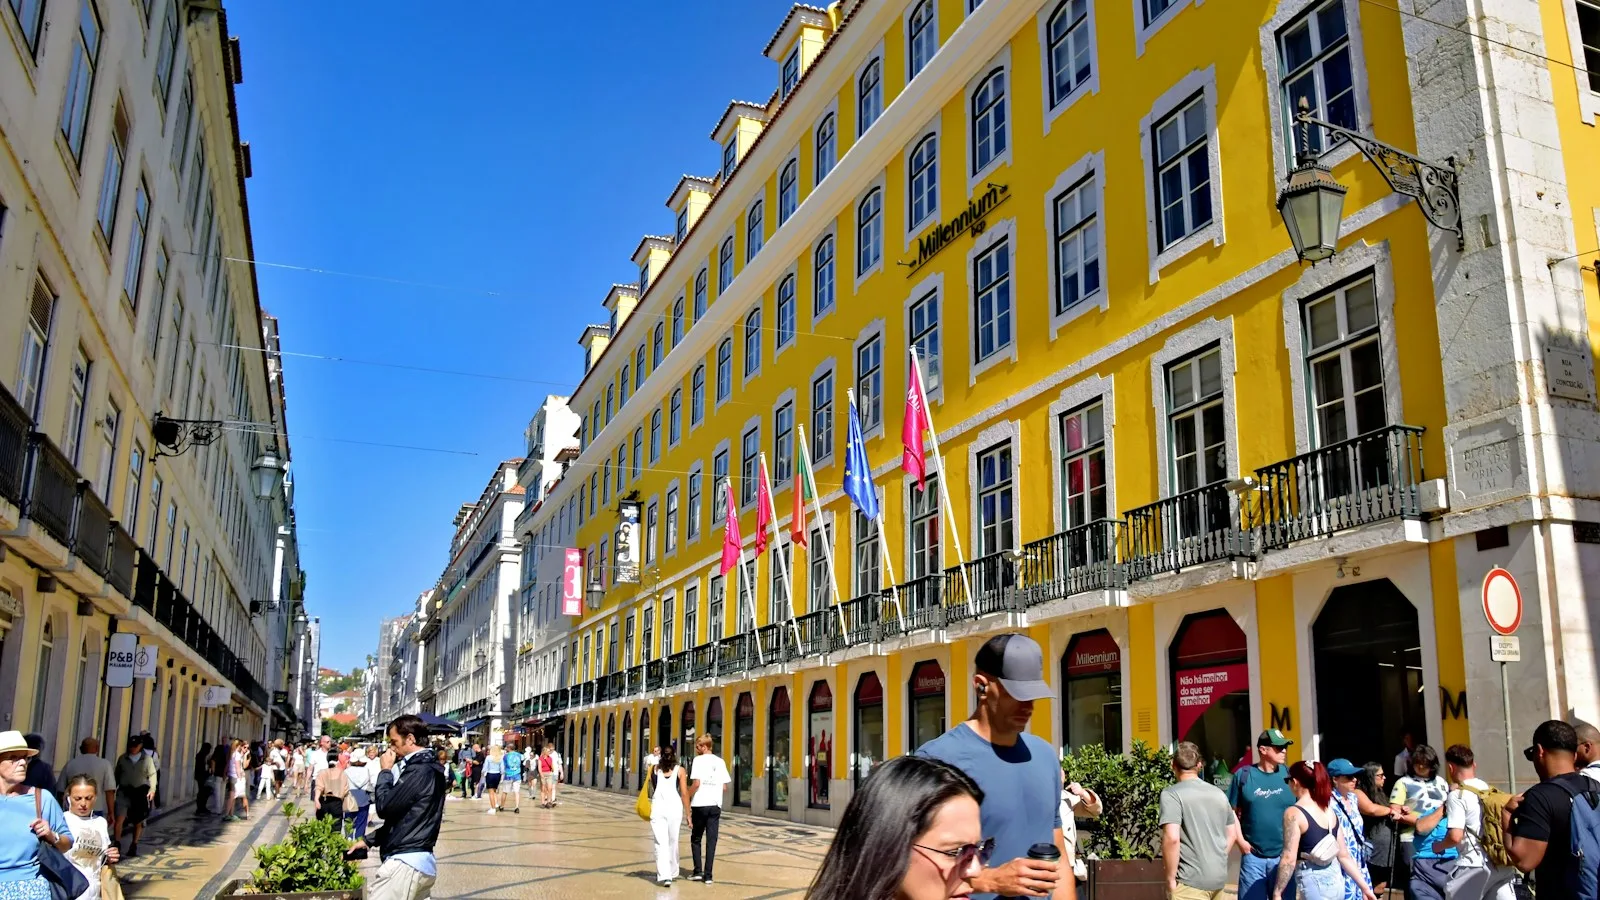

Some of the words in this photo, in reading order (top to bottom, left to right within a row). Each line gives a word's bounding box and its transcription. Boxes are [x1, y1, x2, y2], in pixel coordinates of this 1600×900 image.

[917, 187, 998, 265] Millennium
[970, 220, 987, 238] bcp
[1561, 359, 1573, 367] RUA
[1564, 369, 1572, 377] DA
[110, 651, 133, 663] P&B
[1075, 650, 1118, 666] Millennium
[1180, 675, 1194, 686] Não
[1193, 674, 1203, 684] há
[1203, 672, 1227, 683] melhor
[1180, 686, 1190, 696] do
[1190, 686, 1203, 697] que
[1203, 685, 1214, 694] ser
[1187, 695, 1210, 705] melhor
[1437, 685, 1469, 721] M
[1269, 702, 1292, 731] M
